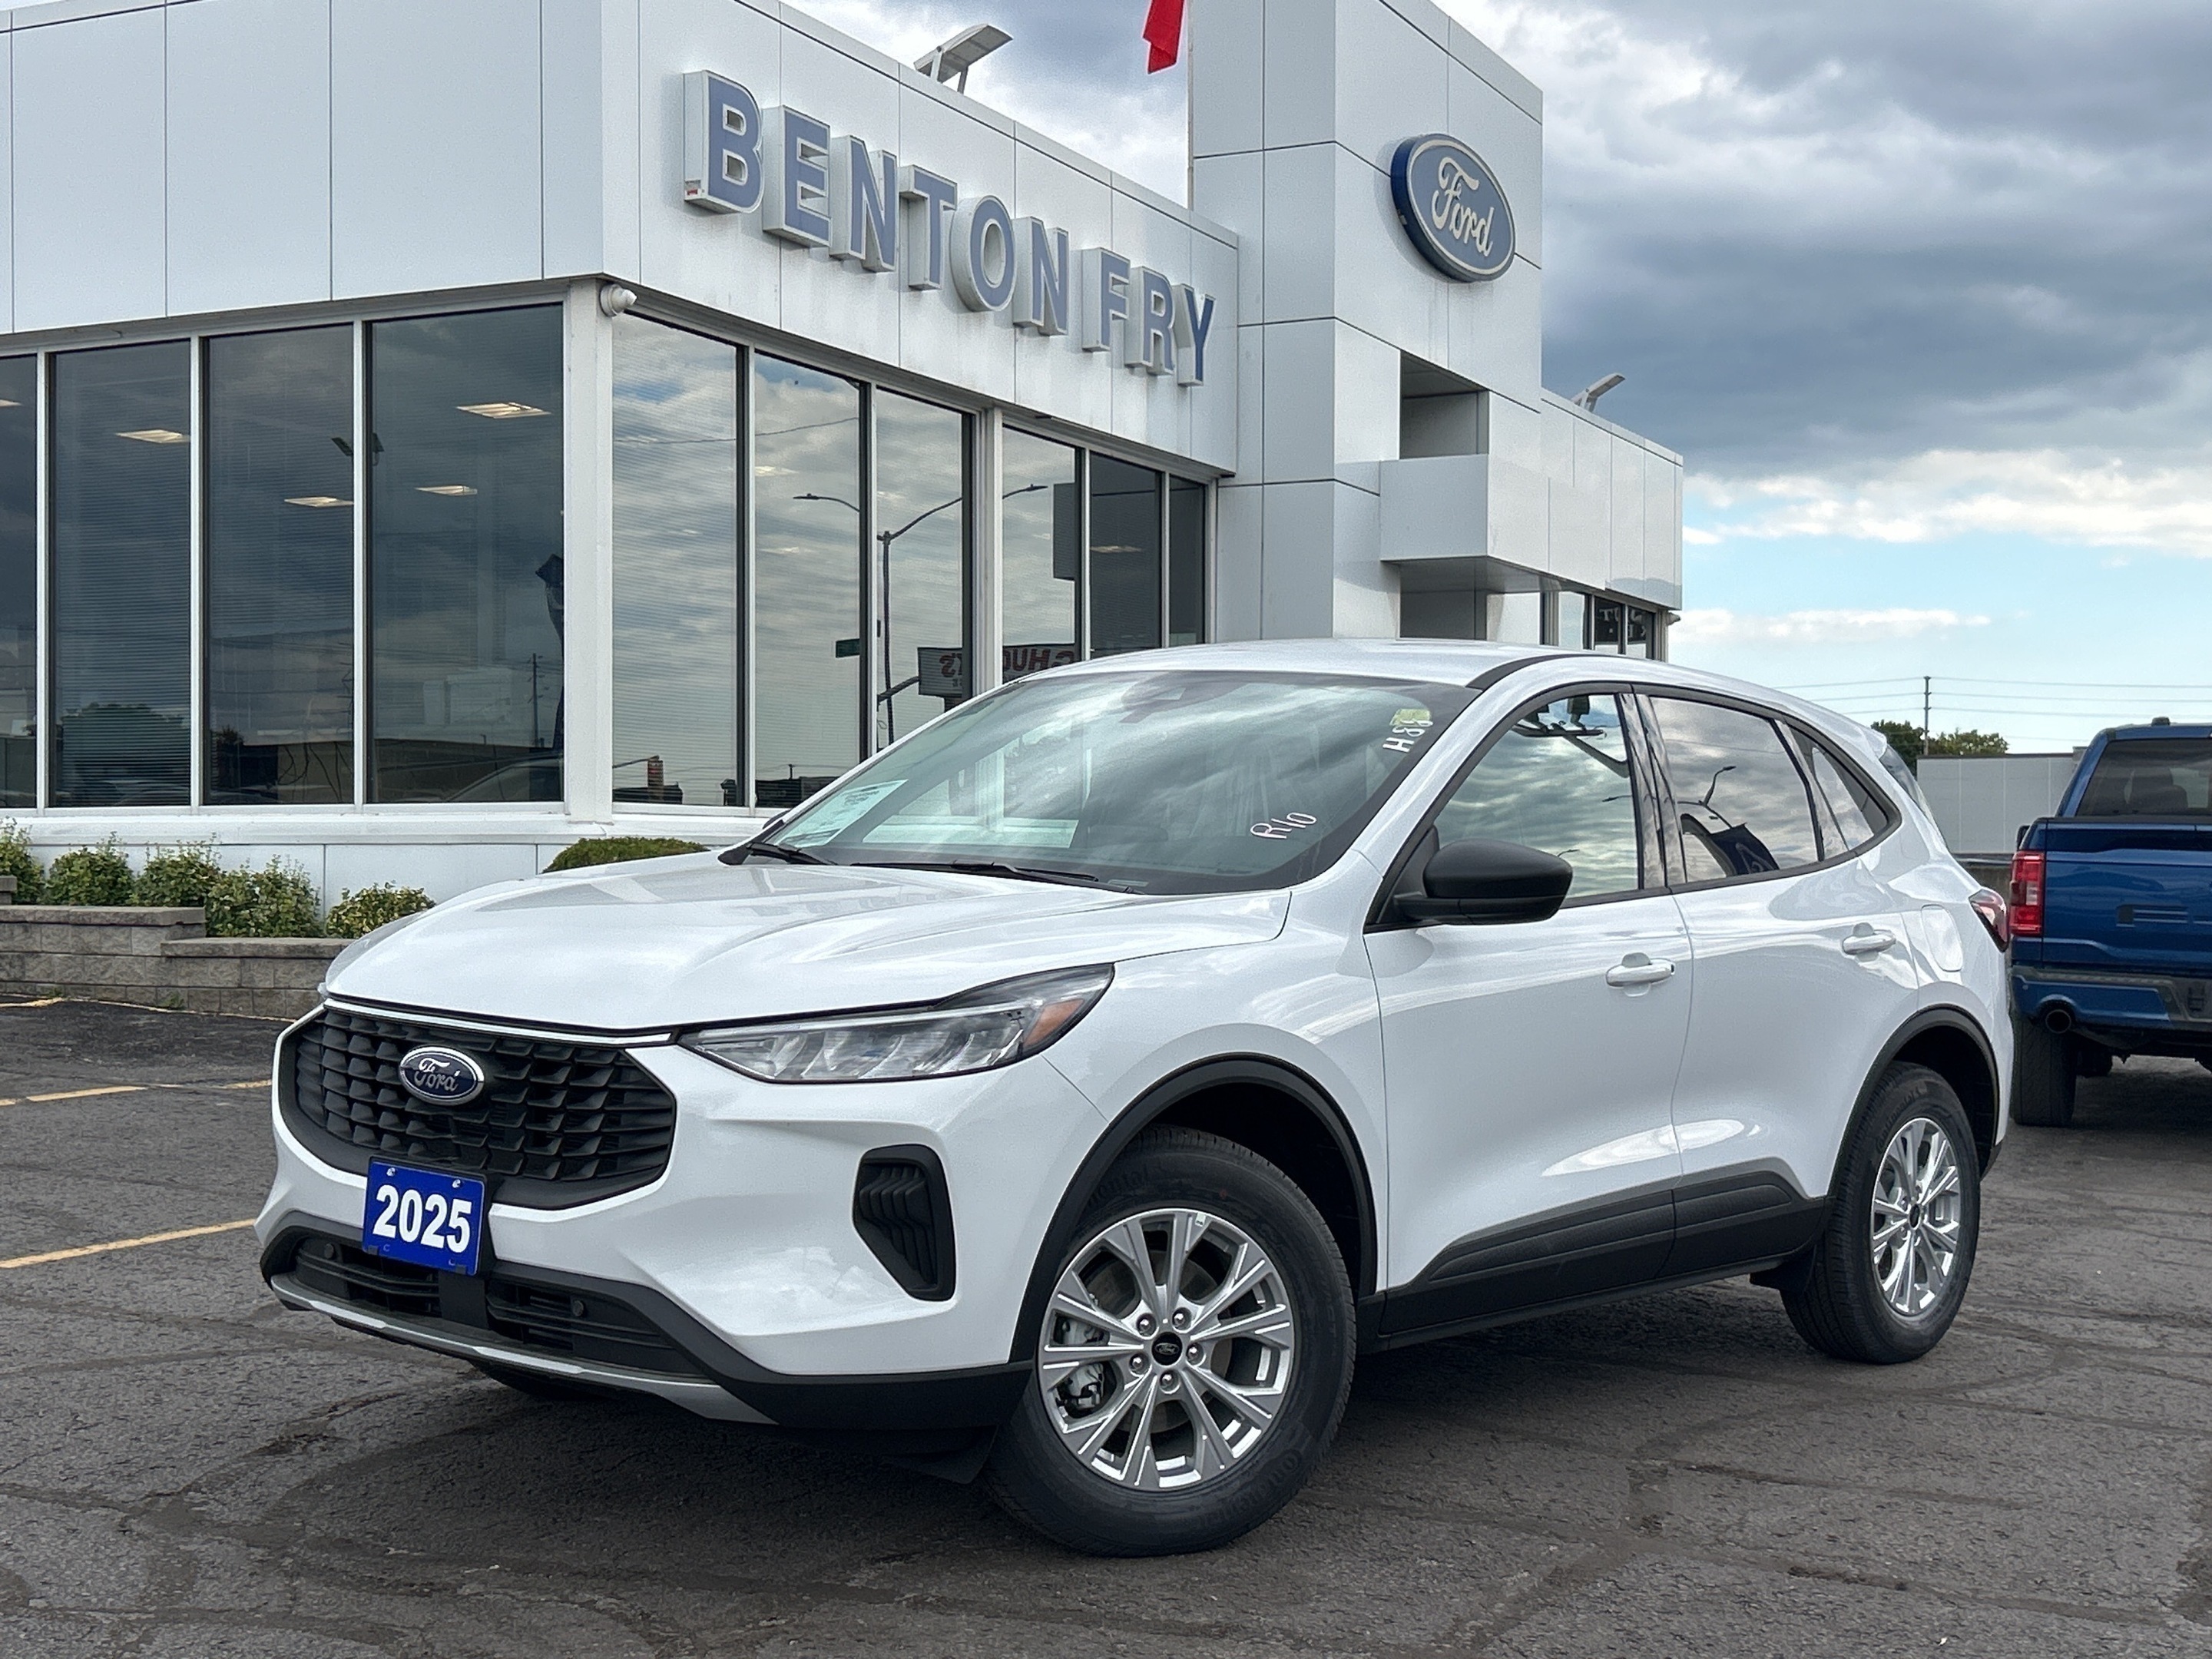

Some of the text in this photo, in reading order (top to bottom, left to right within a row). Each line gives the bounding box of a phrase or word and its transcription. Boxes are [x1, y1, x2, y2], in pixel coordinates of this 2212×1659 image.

[704, 70, 1217, 386] BENTON FRY
[1431, 156, 1495, 257] Ford
[414, 1056, 461, 1092] Ford
[372, 1184, 472, 1253] 2025
